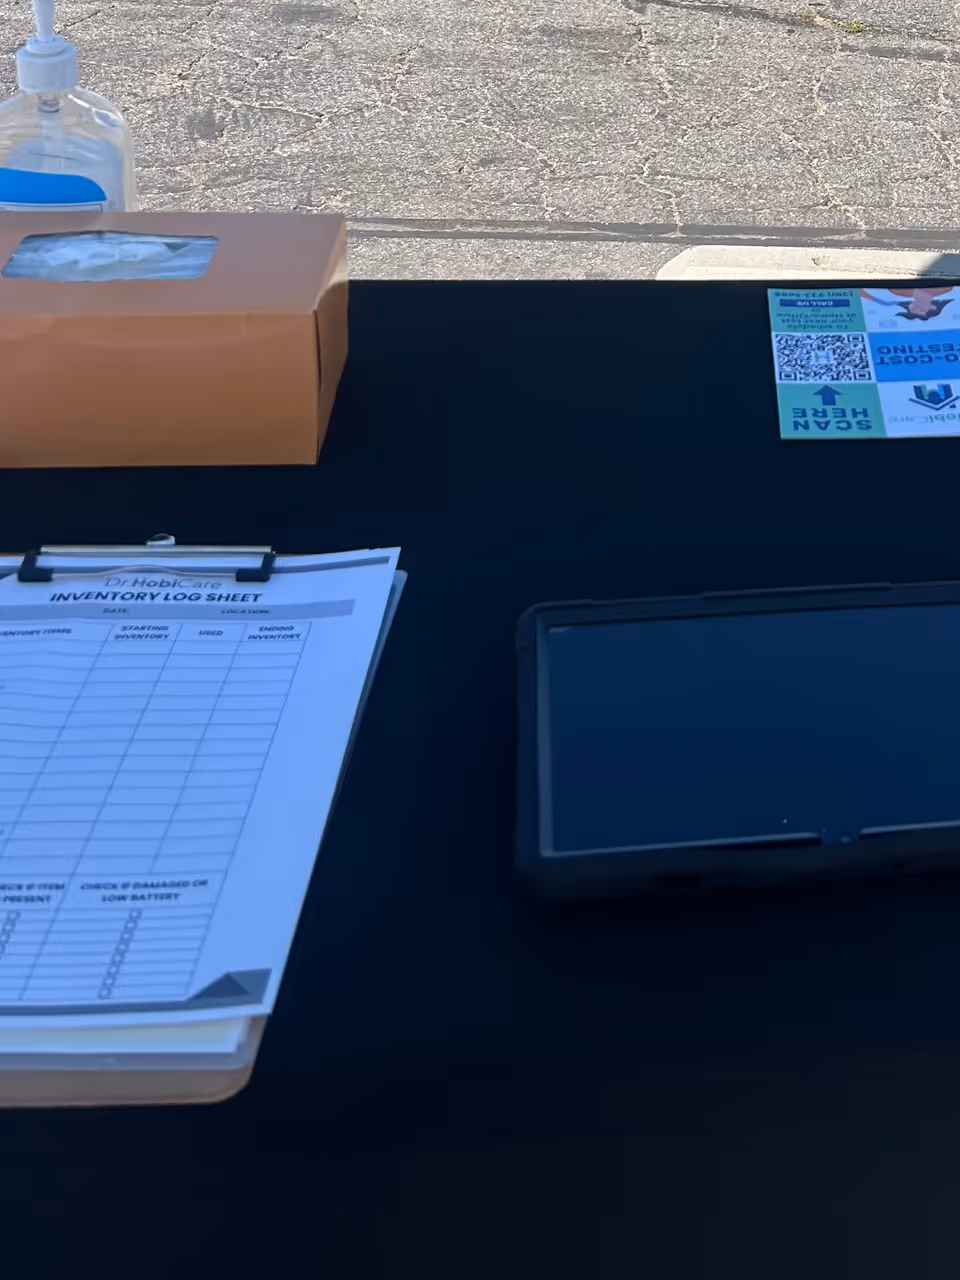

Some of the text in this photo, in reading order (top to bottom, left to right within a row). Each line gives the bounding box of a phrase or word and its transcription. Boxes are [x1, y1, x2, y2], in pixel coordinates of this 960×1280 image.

[792, 407, 869, 418] HERE
[793, 419, 873, 431] SCAN
[50, 591, 263, 603] INVENTORY LOG SHEET
[80, 883, 118, 891] CHECK
[133, 880, 191, 890] DAMAGED
[192, 879, 209, 888] OR
[101, 893, 181, 903] LOW BATTERY
